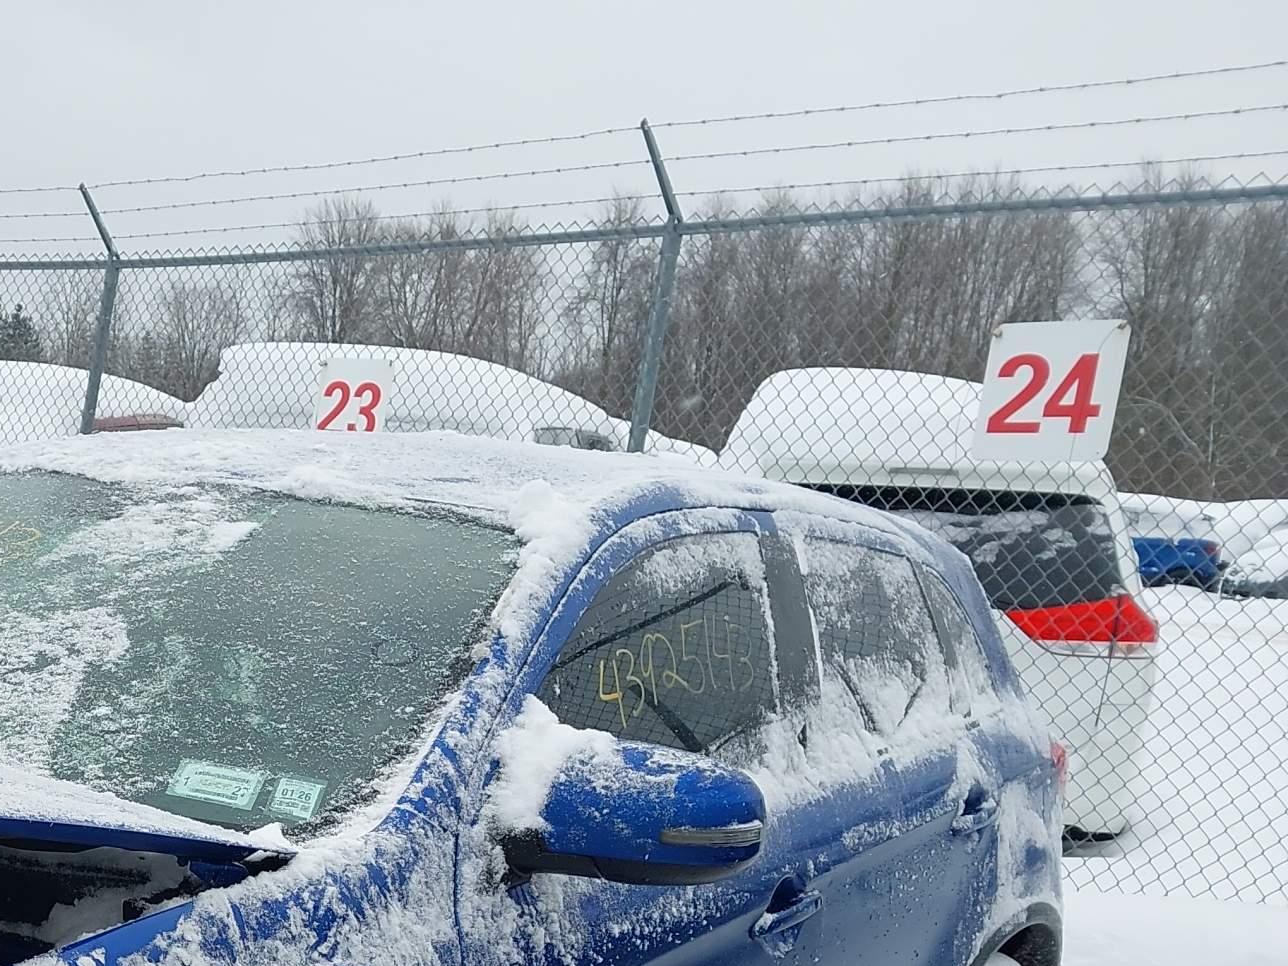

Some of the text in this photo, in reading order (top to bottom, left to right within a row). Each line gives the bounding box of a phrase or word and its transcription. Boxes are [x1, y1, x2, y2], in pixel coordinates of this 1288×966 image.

[316, 380, 383, 432] 23
[985, 352, 1101, 434] 24
[598, 613, 755, 729] 43925143
[281, 787, 312, 801] 01 26
